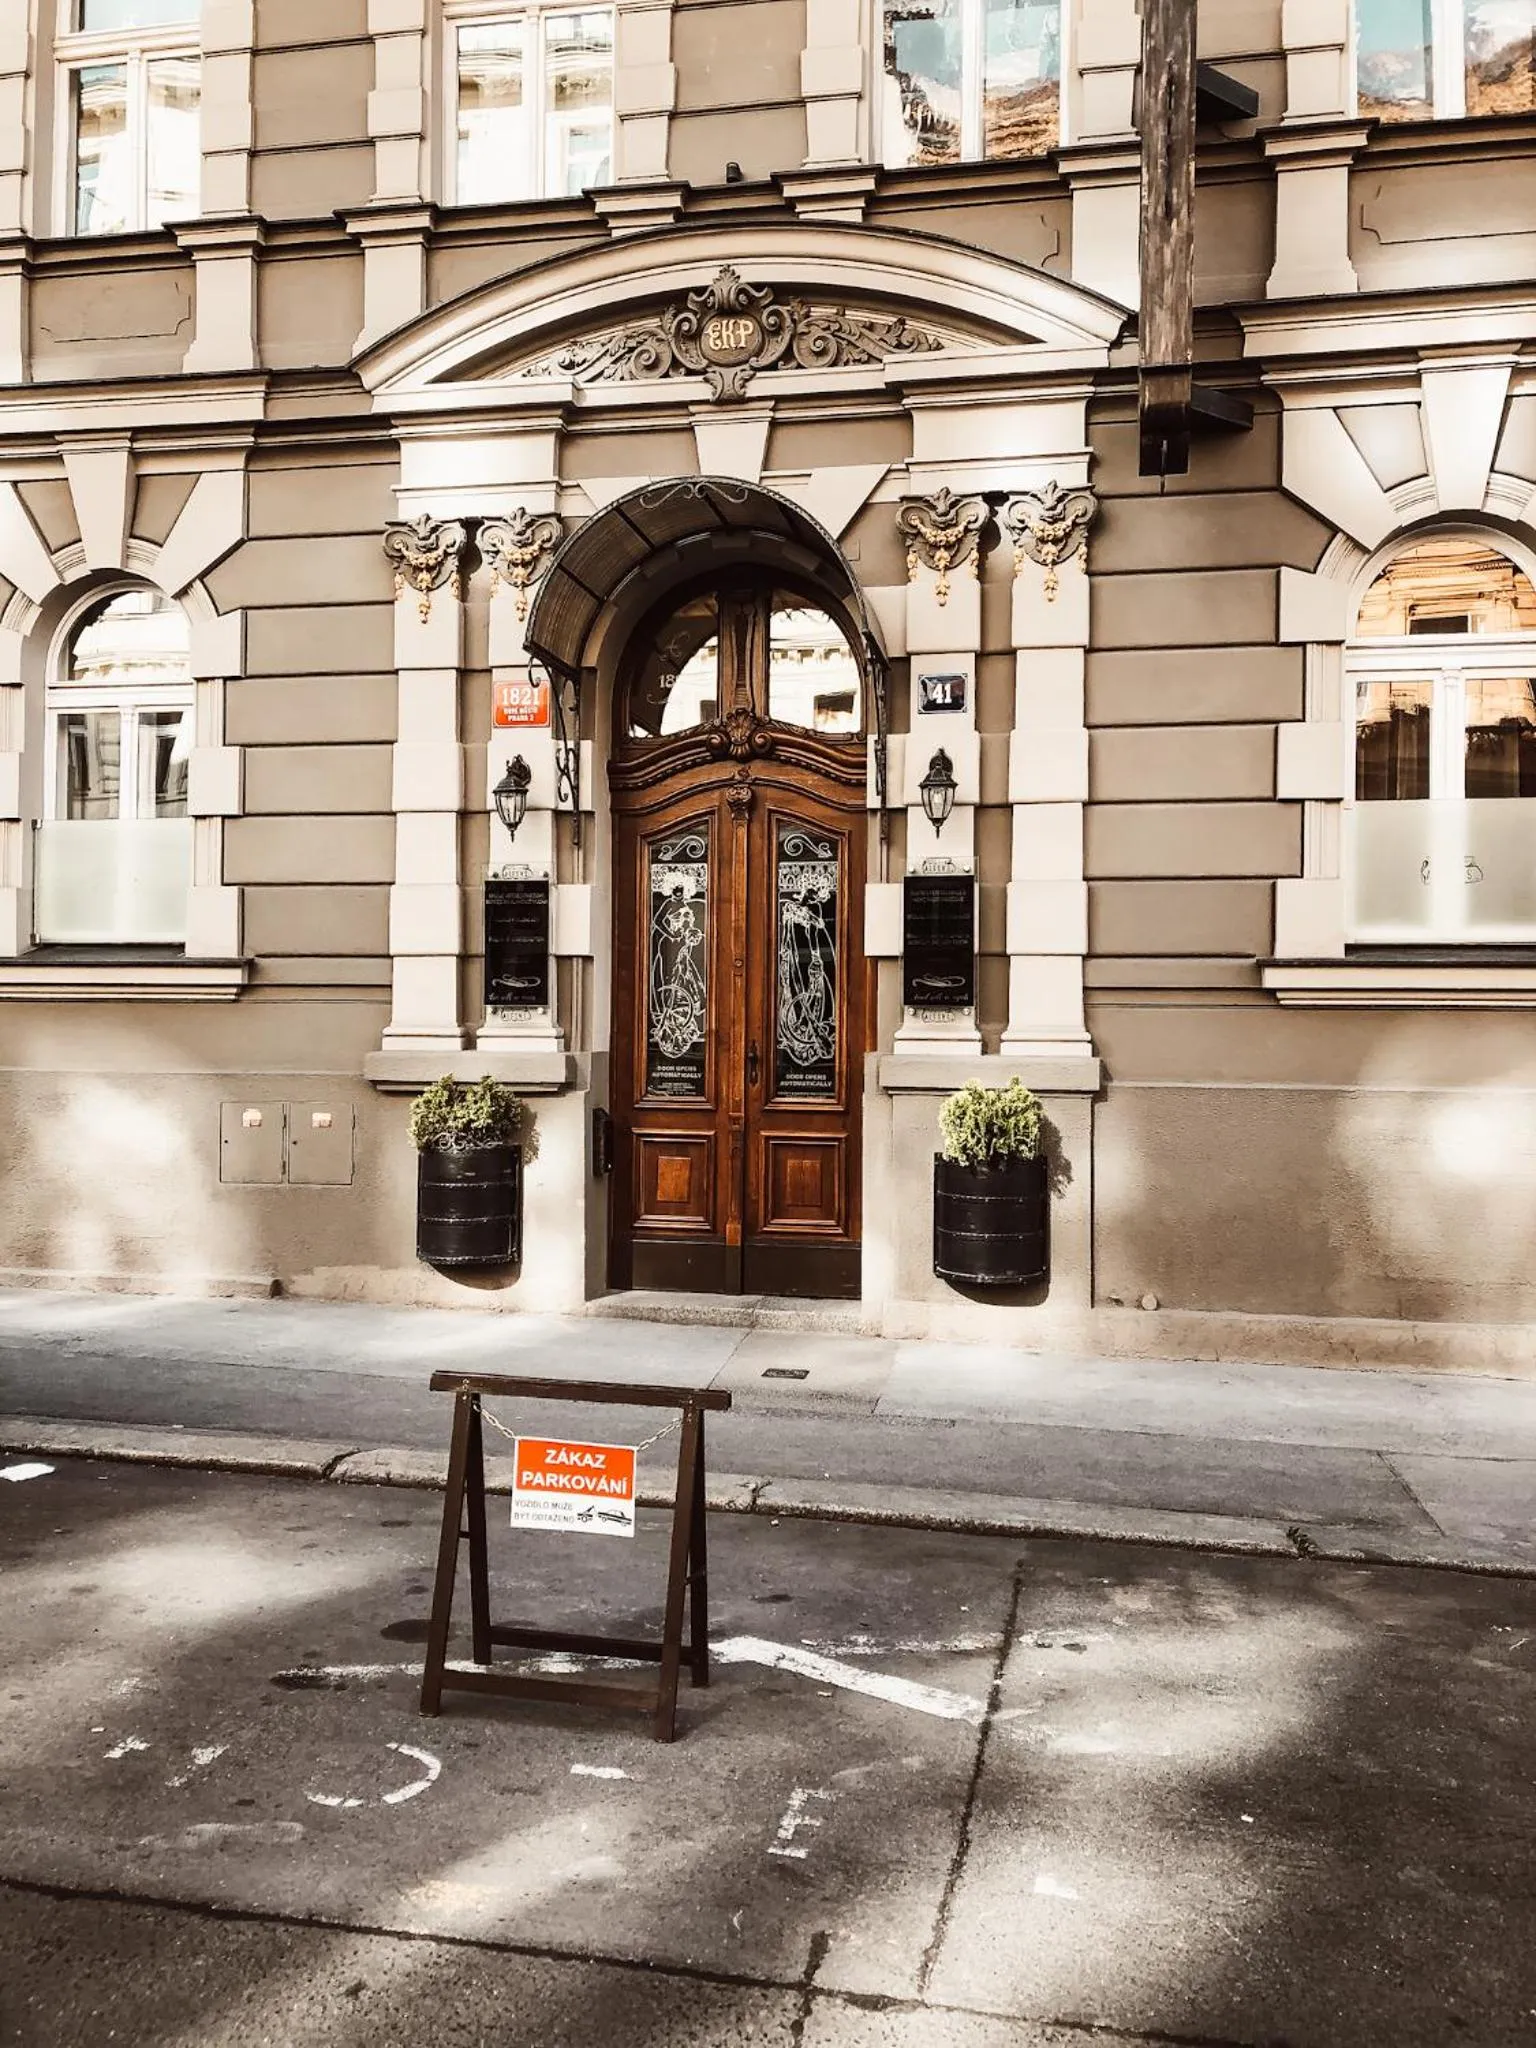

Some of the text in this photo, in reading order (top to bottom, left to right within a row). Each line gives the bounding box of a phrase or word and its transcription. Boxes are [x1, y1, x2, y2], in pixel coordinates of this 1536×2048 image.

[502, 687, 540, 705] 1821
[932, 683, 952, 704] 41
[544, 1447, 607, 1468] ZÁKAZ
[521, 1470, 628, 1495] PARKOVÁNÍ
[514, 1498, 549, 1509] VOZIDLO
